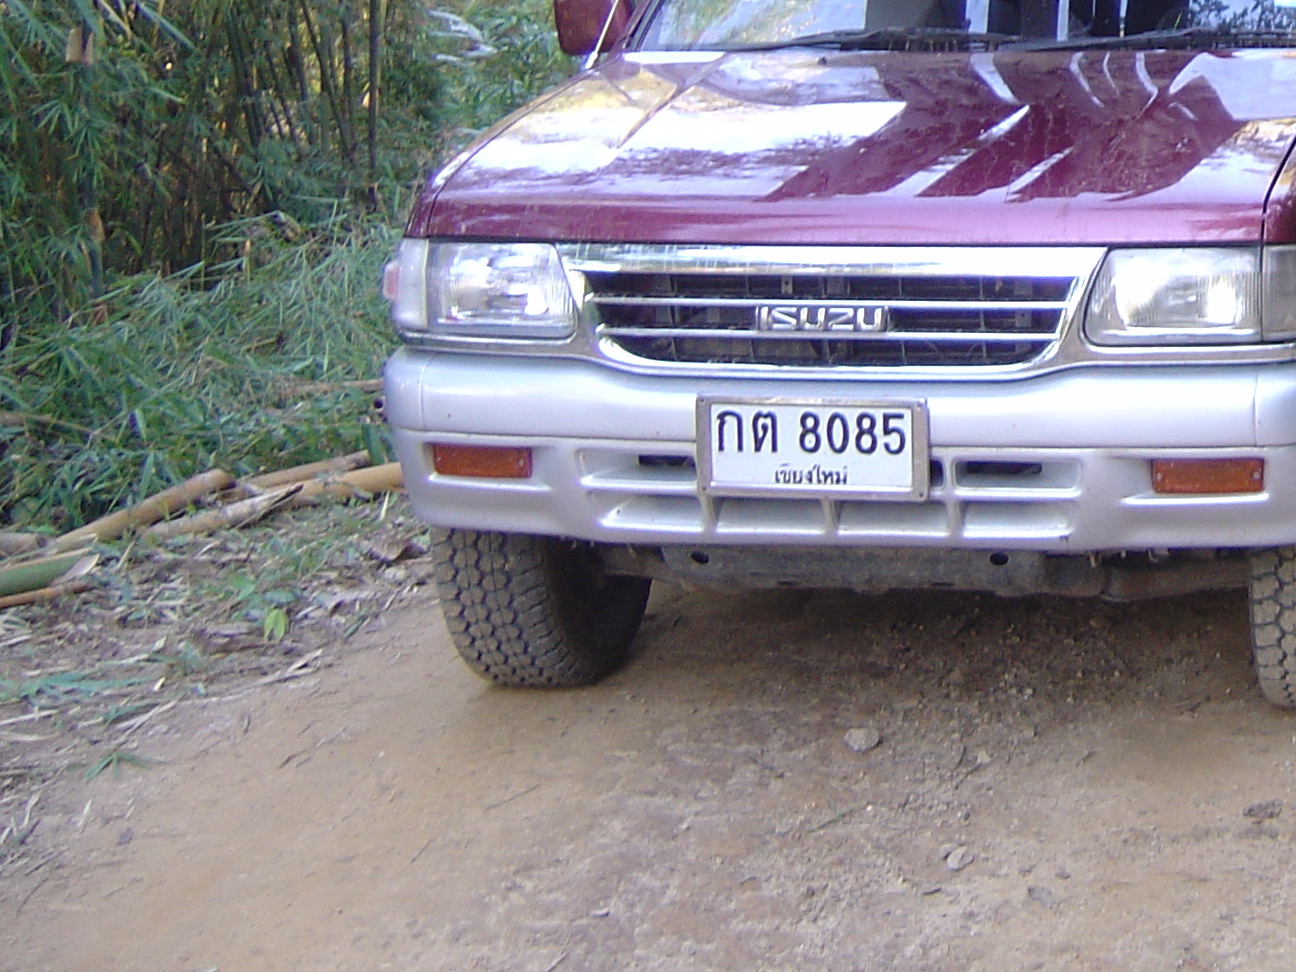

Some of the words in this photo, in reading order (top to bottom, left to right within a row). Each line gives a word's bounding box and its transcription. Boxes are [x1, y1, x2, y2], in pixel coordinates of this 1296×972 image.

[759, 306, 883, 331] ISUZU
[716, 409, 778, 452] กต
[799, 411, 906, 455] 8085
